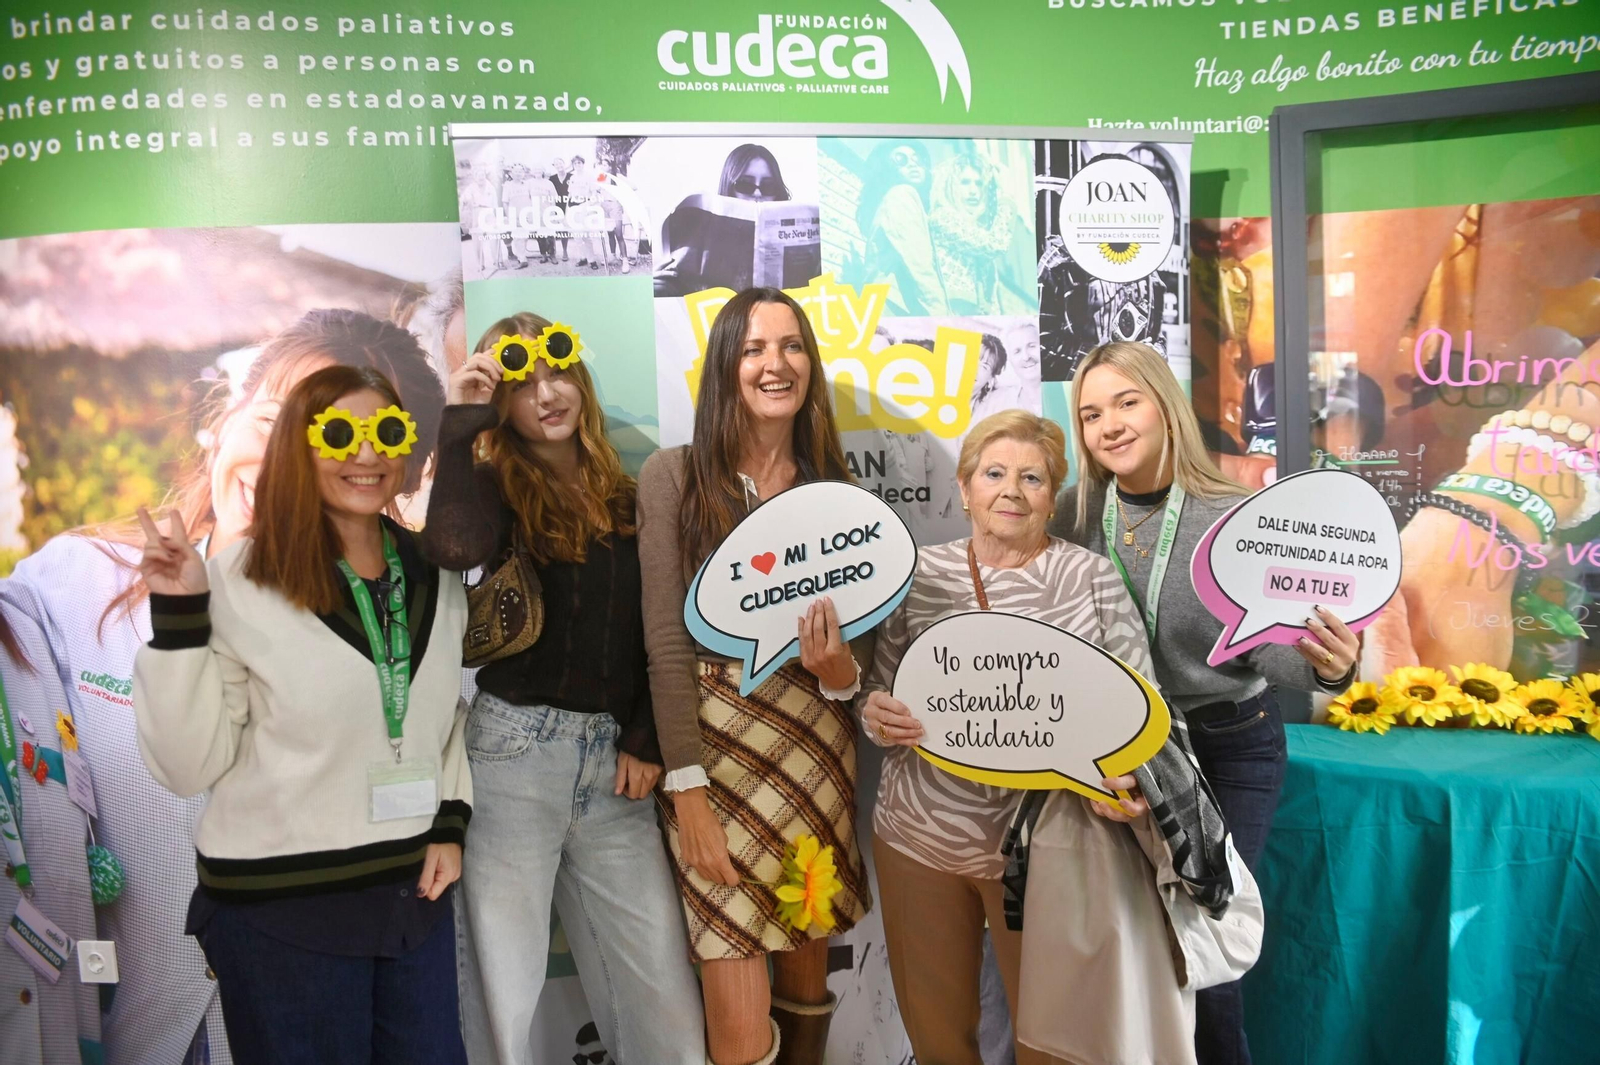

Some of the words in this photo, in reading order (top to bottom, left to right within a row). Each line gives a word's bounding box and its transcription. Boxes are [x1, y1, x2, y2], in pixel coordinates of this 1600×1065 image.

[11, 10, 133, 39] brindar
[151, 9, 319, 32] cuidados
[338, 13, 514, 37] paliativos
[775, 14, 887, 30] FUNDACIÓN
[1219, 12, 1360, 40] TIENDAS
[657, 14, 889, 80] cudeca
[46, 58, 59, 80] y
[76, 48, 244, 77] gratuitos
[264, 54, 279, 69] a
[299, 54, 460, 74] personas
[477, 58, 535, 74] con
[1194, 56, 1245, 94] Haz
[1251, 54, 1309, 92] algo
[1316, 50, 1403, 81] bonito
[1410, 51, 1461, 73] con
[1468, 39, 1503, 67] tu
[1510, 34, 1600, 64] tiemp
[247, 93, 286, 108] en
[306, 89, 602, 115] estadoavanzado,
[658, 81, 719, 92] CUIDADOS
[722, 82, 786, 93] PALIATIVOS
[796, 84, 857, 94] PALLIATIVE
[860, 85, 889, 94] CARE
[76, 129, 217, 153] integral
[237, 131, 252, 147] a
[272, 131, 329, 147] sus
[1086, 181, 1147, 206] JOAN
[477, 195, 606, 232] cudeca
[1068, 213, 1126, 224] CHARITY
[1130, 213, 1164, 224] SHOP
[778, 230, 791, 239] The
[792, 229, 807, 239] New
[870, 483, 931, 504] deca
[1258, 516, 1289, 532] DALE
[1292, 521, 1317, 536] UNA
[1320, 525, 1376, 544] SEGUNDA
[730, 562, 742, 581] I
[784, 543, 806, 566] MI
[820, 521, 881, 555] LOOK
[1236, 539, 1326, 562] OPORTUNIDAD
[1329, 552, 1337, 564] A
[1340, 553, 1355, 566] LA
[1357, 555, 1388, 570] ROPA
[740, 561, 874, 612] CUDEQUERO
[1270, 575, 1293, 591] NO
[1296, 578, 1306, 593] A
[1311, 579, 1329, 595] TU
[1332, 582, 1350, 598] EX
[933, 646, 960, 675] Yo
[973, 651, 1060, 683] compro
[927, 683, 1040, 712] sostenible
[1048, 693, 1065, 722] y
[945, 718, 1055, 748] solidario
[17, 921, 62, 966] VOLUNTARIO
